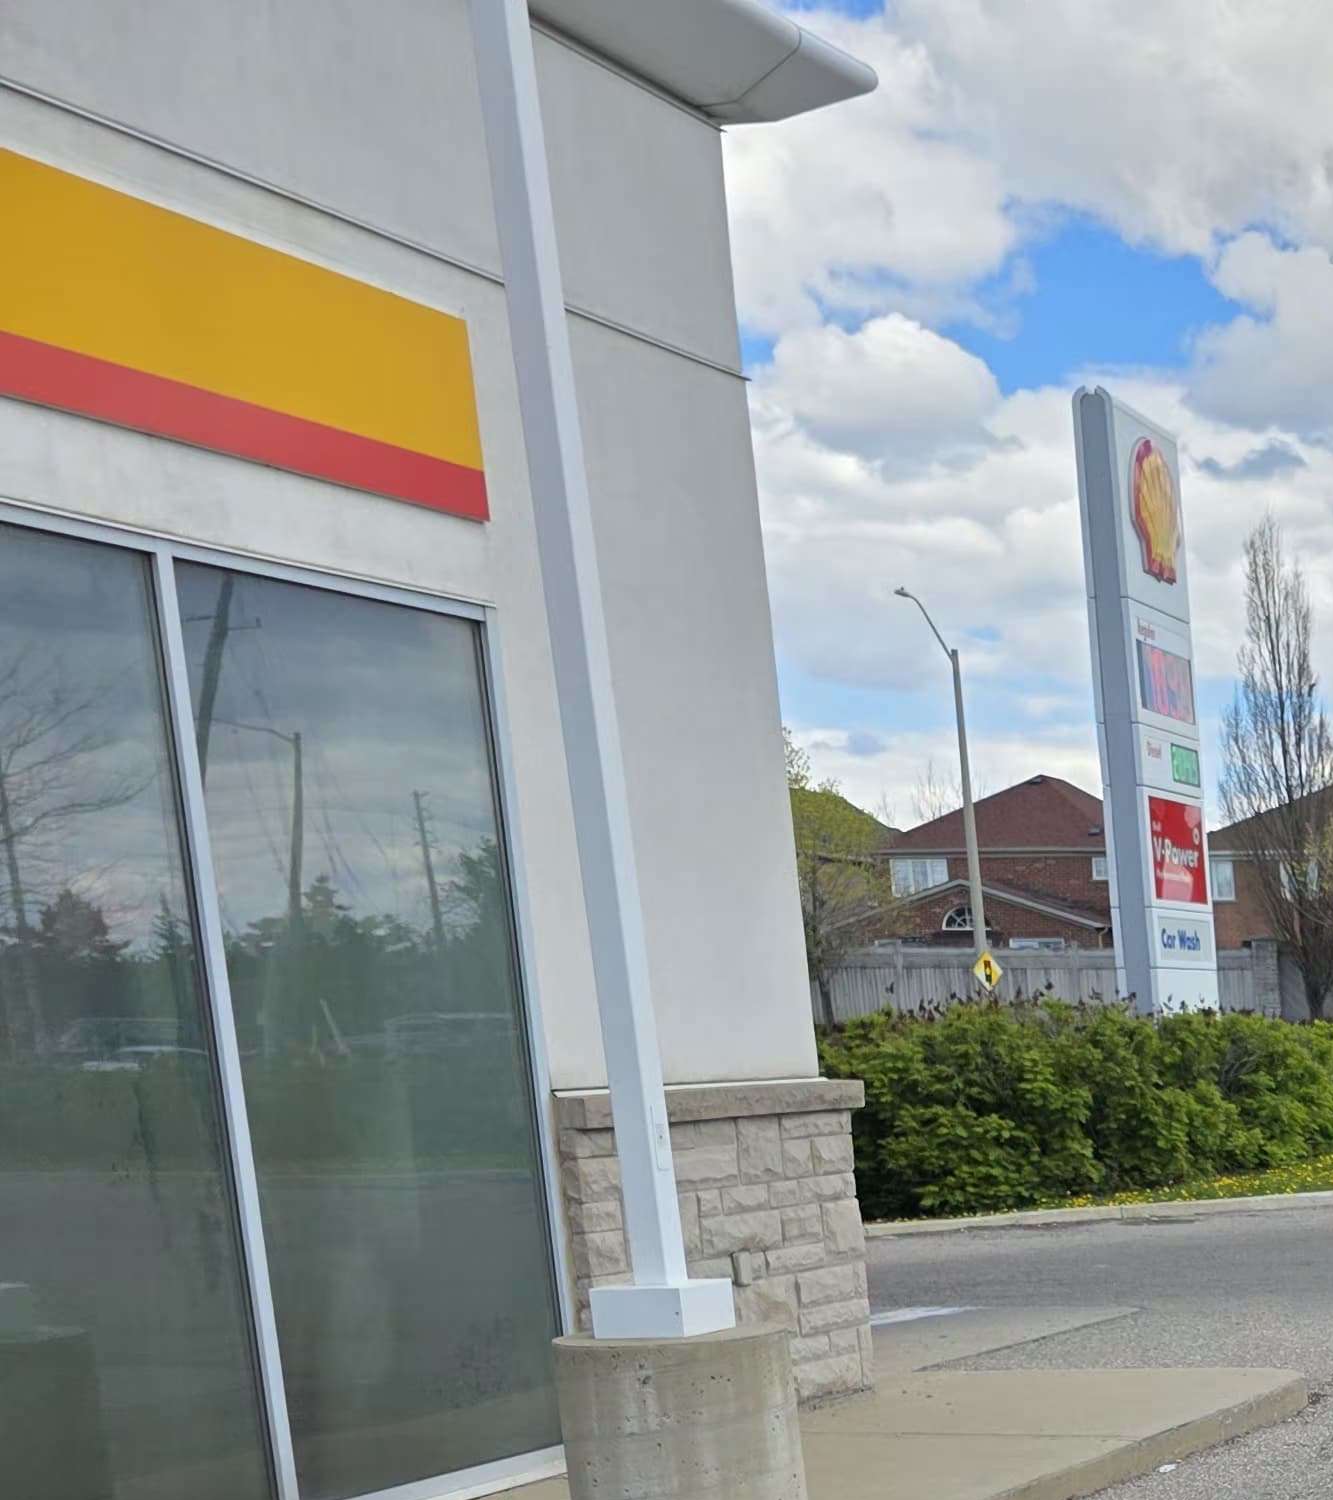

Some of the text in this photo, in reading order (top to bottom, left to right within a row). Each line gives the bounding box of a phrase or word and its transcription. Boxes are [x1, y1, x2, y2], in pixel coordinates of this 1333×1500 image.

[1152, 836, 1200, 868] V-Power
[1161, 927, 1201, 951] Car Wash
